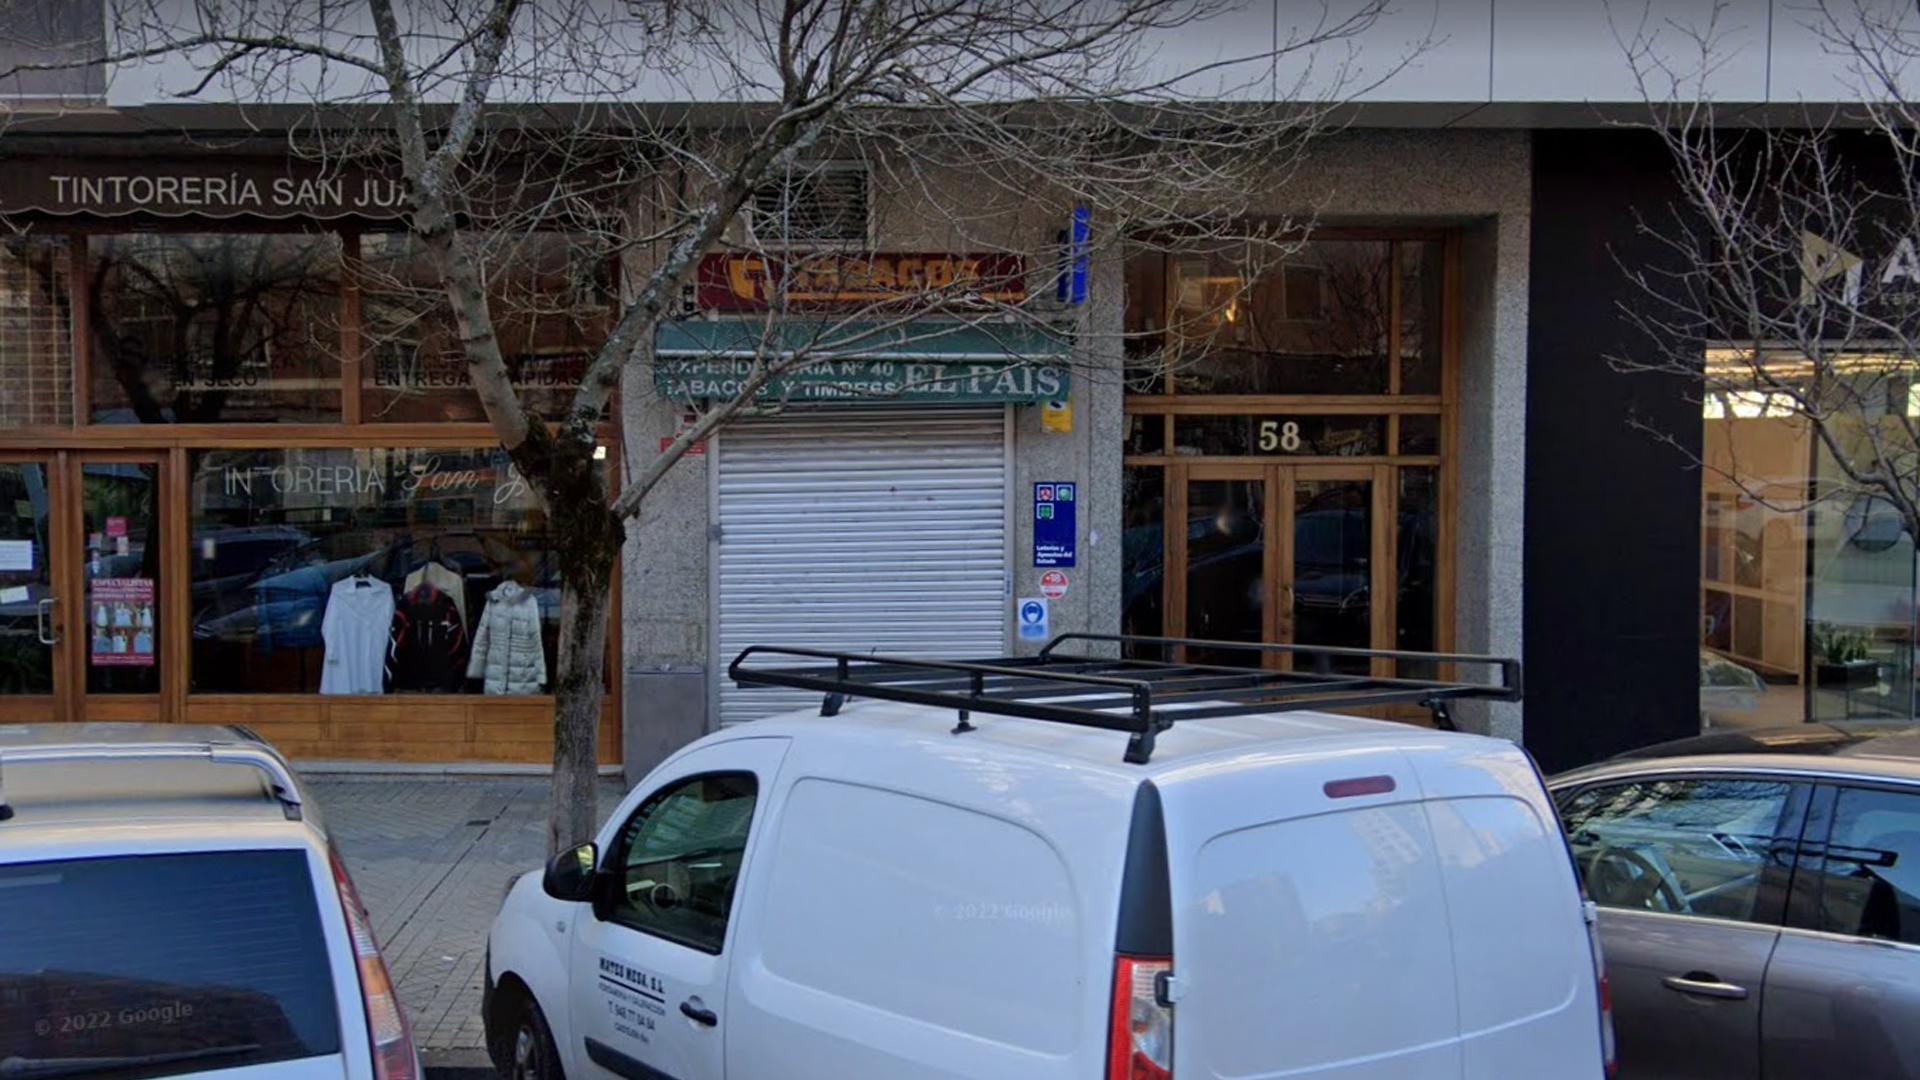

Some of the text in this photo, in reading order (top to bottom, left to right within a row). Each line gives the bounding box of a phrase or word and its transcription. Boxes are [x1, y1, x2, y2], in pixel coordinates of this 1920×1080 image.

[50, 172, 261, 206] TINTORERÍA
[272, 178, 343, 206] SAN
[374, 371, 583, 387] ENTREGA APIDAS
[869, 361, 894, 376] 40
[904, 364, 956, 393] EL
[781, 380, 797, 396] Y
[1259, 421, 1300, 451] 58
